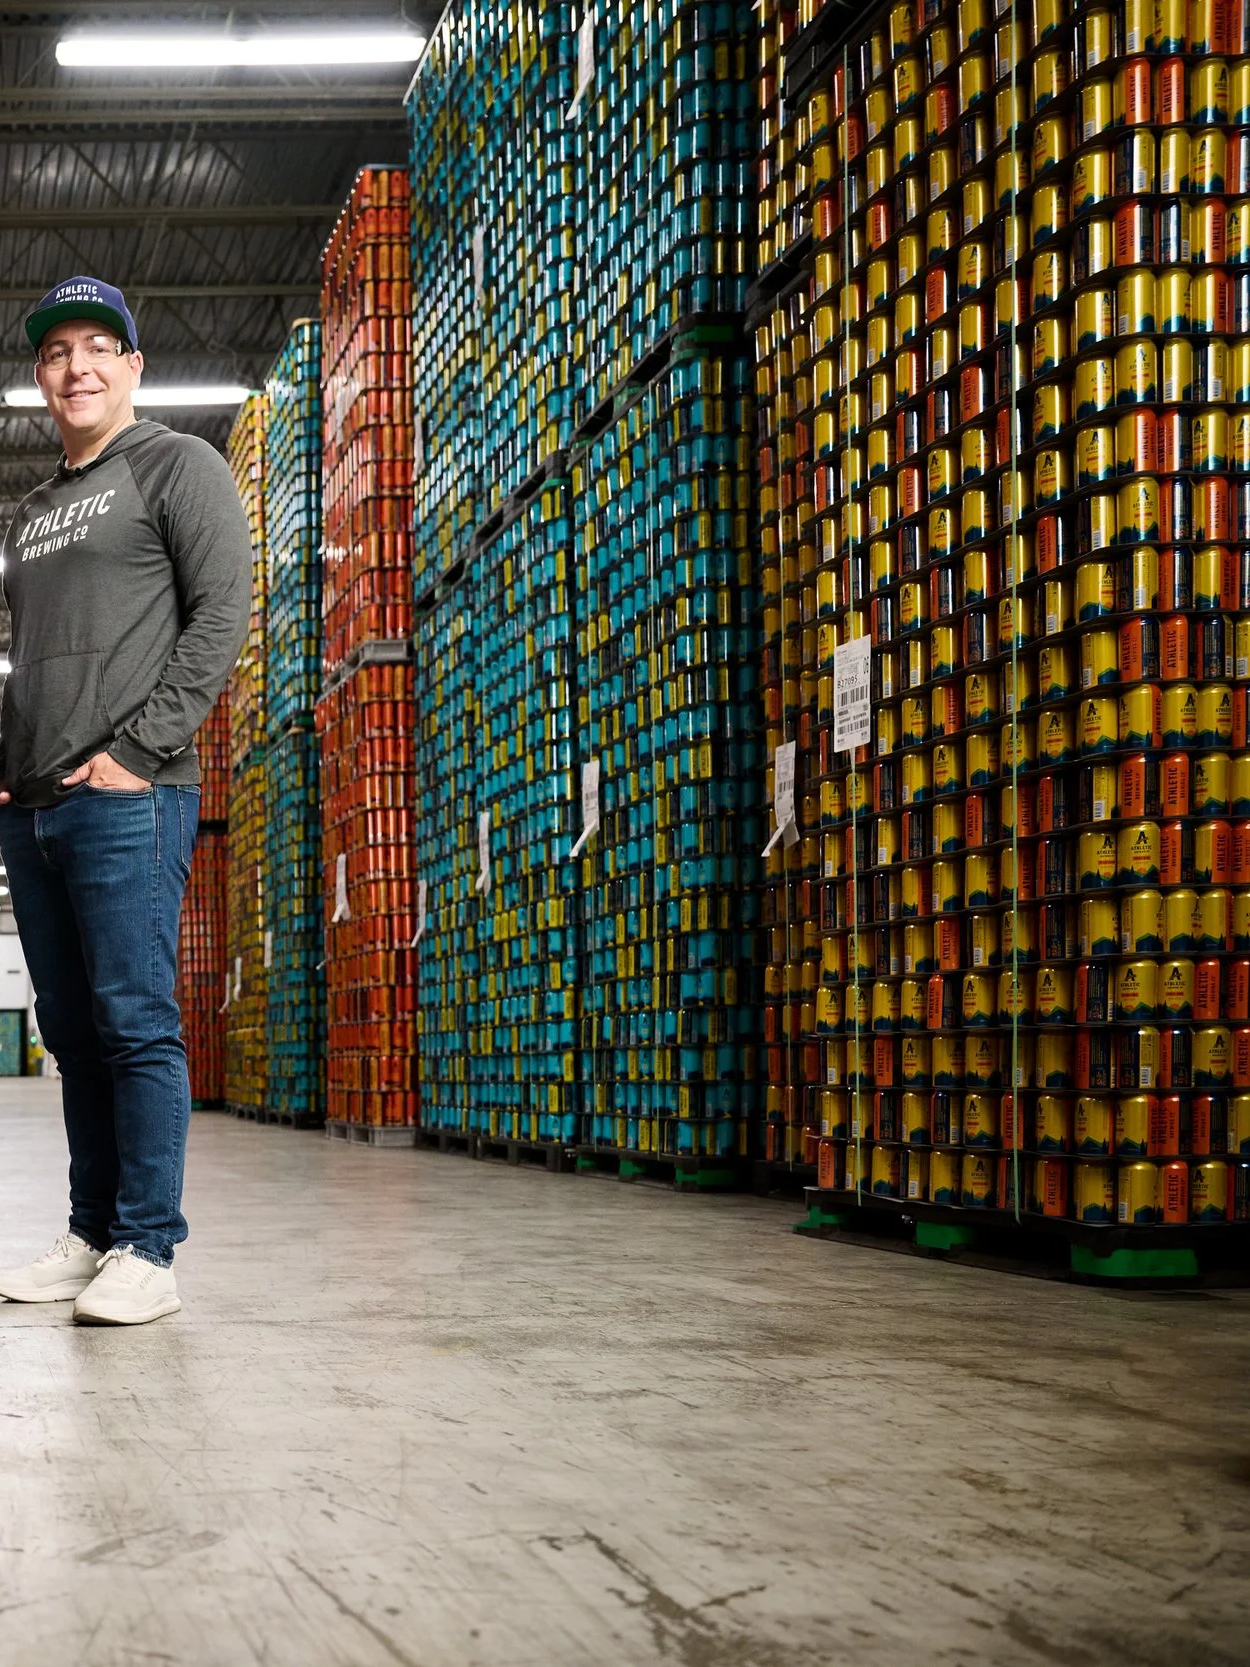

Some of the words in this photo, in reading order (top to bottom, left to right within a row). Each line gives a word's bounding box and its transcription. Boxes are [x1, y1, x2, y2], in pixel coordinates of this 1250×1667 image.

[56, 284, 98, 300] ATHLETIC
[16, 490, 116, 548] ATHLETIC
[22, 532, 70, 562] BREWING
[1168, 630, 1176, 668] ATHLETIC
[1124, 768, 1132, 807] ATHLETIC
[1168, 767, 1177, 805] ATHLETIC
[1160, 836, 1168, 874] ATHLETIC
[1218, 834, 1226, 872] ATHLETIC
[1234, 835, 1242, 872] ATHLETIC
[1198, 972, 1208, 1009] ATHLETIC
[1228, 970, 1237, 1008] ATHLETIC
[1238, 1038, 1248, 1076] ATHLETIC
[1158, 1107, 1167, 1144] ATHLETIC
[1168, 1174, 1178, 1211] ATHLETIC
